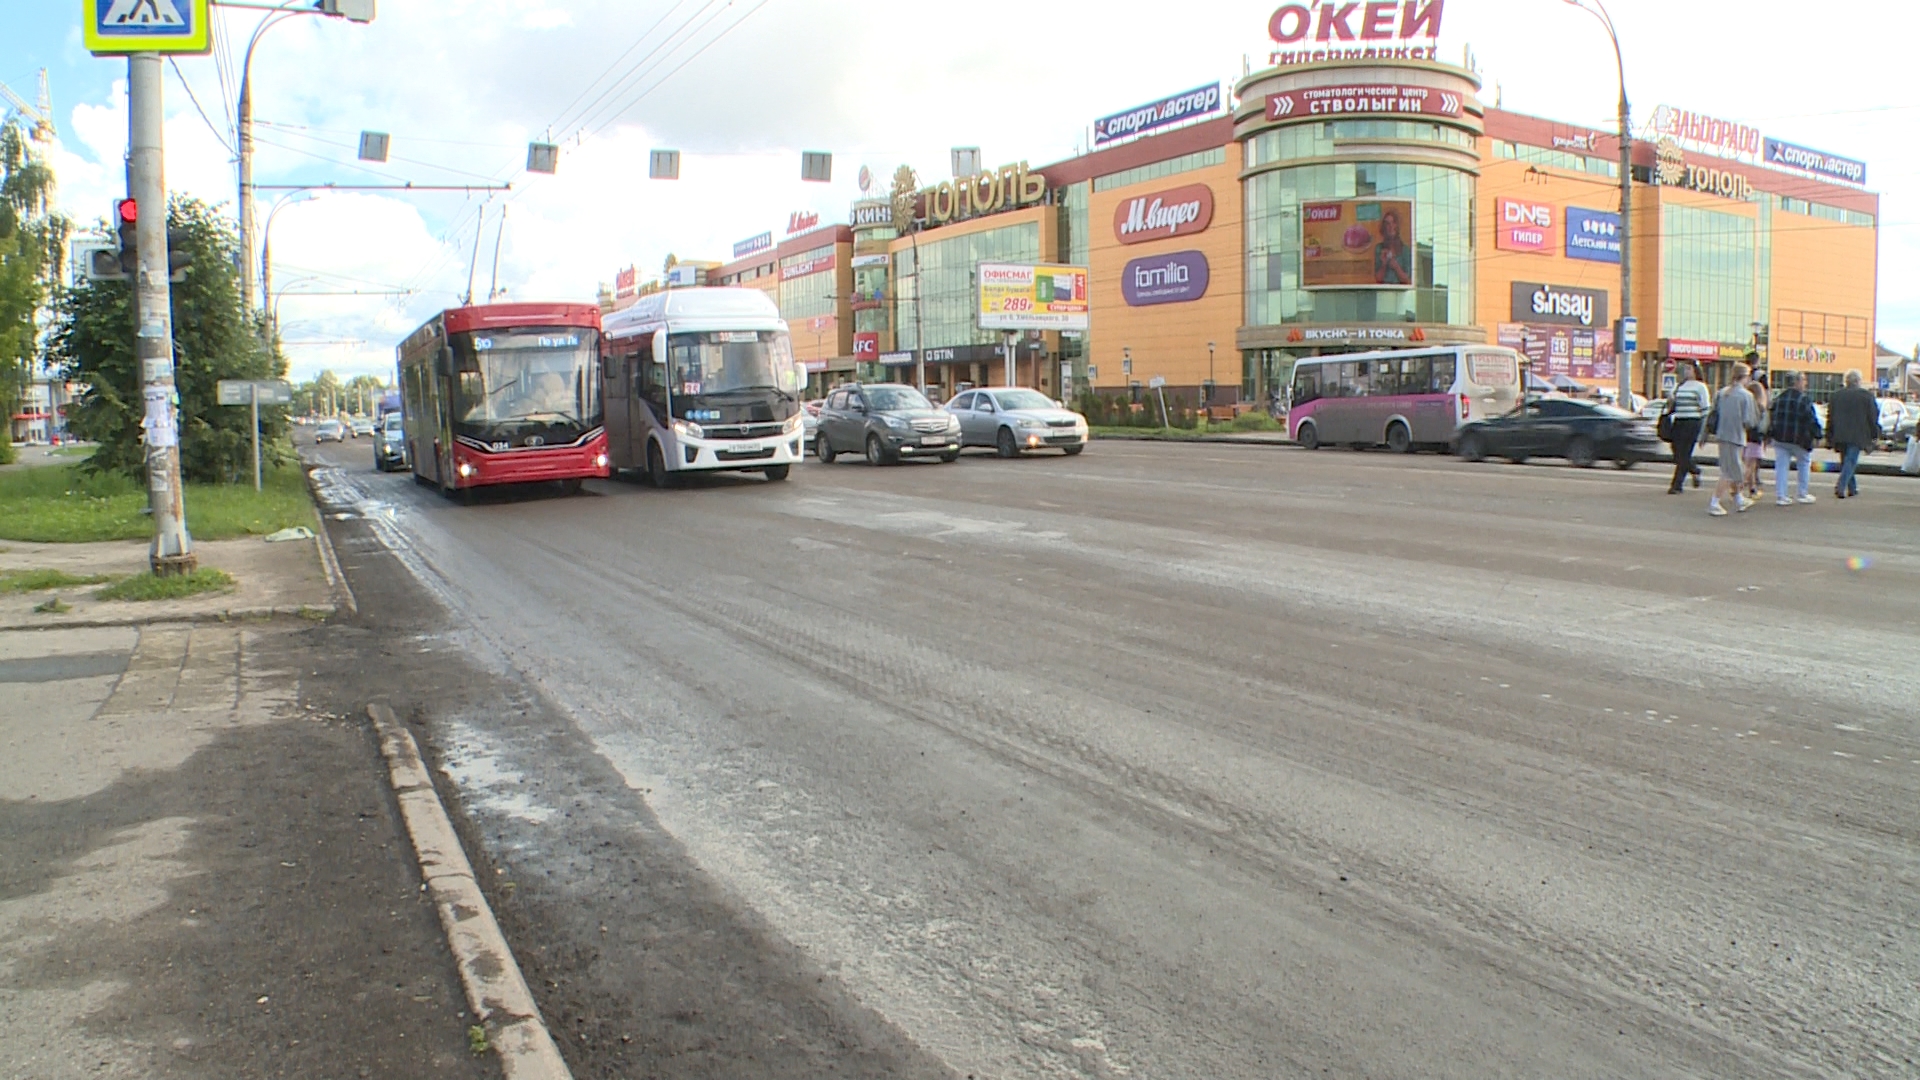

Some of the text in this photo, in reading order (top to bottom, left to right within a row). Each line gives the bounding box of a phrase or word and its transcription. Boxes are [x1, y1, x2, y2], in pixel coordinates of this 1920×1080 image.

[1303, 87, 1428, 99] стоматологический центр
[1310, 97, 1422, 114] СТВОЛЫГИН
[1668, 107, 1759, 154] ЭЛЬДОРАДО
[1686, 163, 1753, 197] ТОПОЛЬ
[920, 160, 1046, 226] ТОПОЛЬ
[1504, 201, 1550, 227] DNS
[1513, 229, 1543, 244] ГИПЕР
[1571, 233, 1608, 251] Детский
[783, 260, 814, 279] SUNLIGHT
[984, 270, 1032, 279] ОФИСМАГ
[1135, 261, 1189, 288] familia
[1004, 296, 1028, 311] 289
[1532, 285, 1593, 325] sinsay
[1305, 329, 1348, 339] ВКУСНО
[1368, 329, 1405, 339] ТОЧКА
[852, 339, 874, 353] KFC
